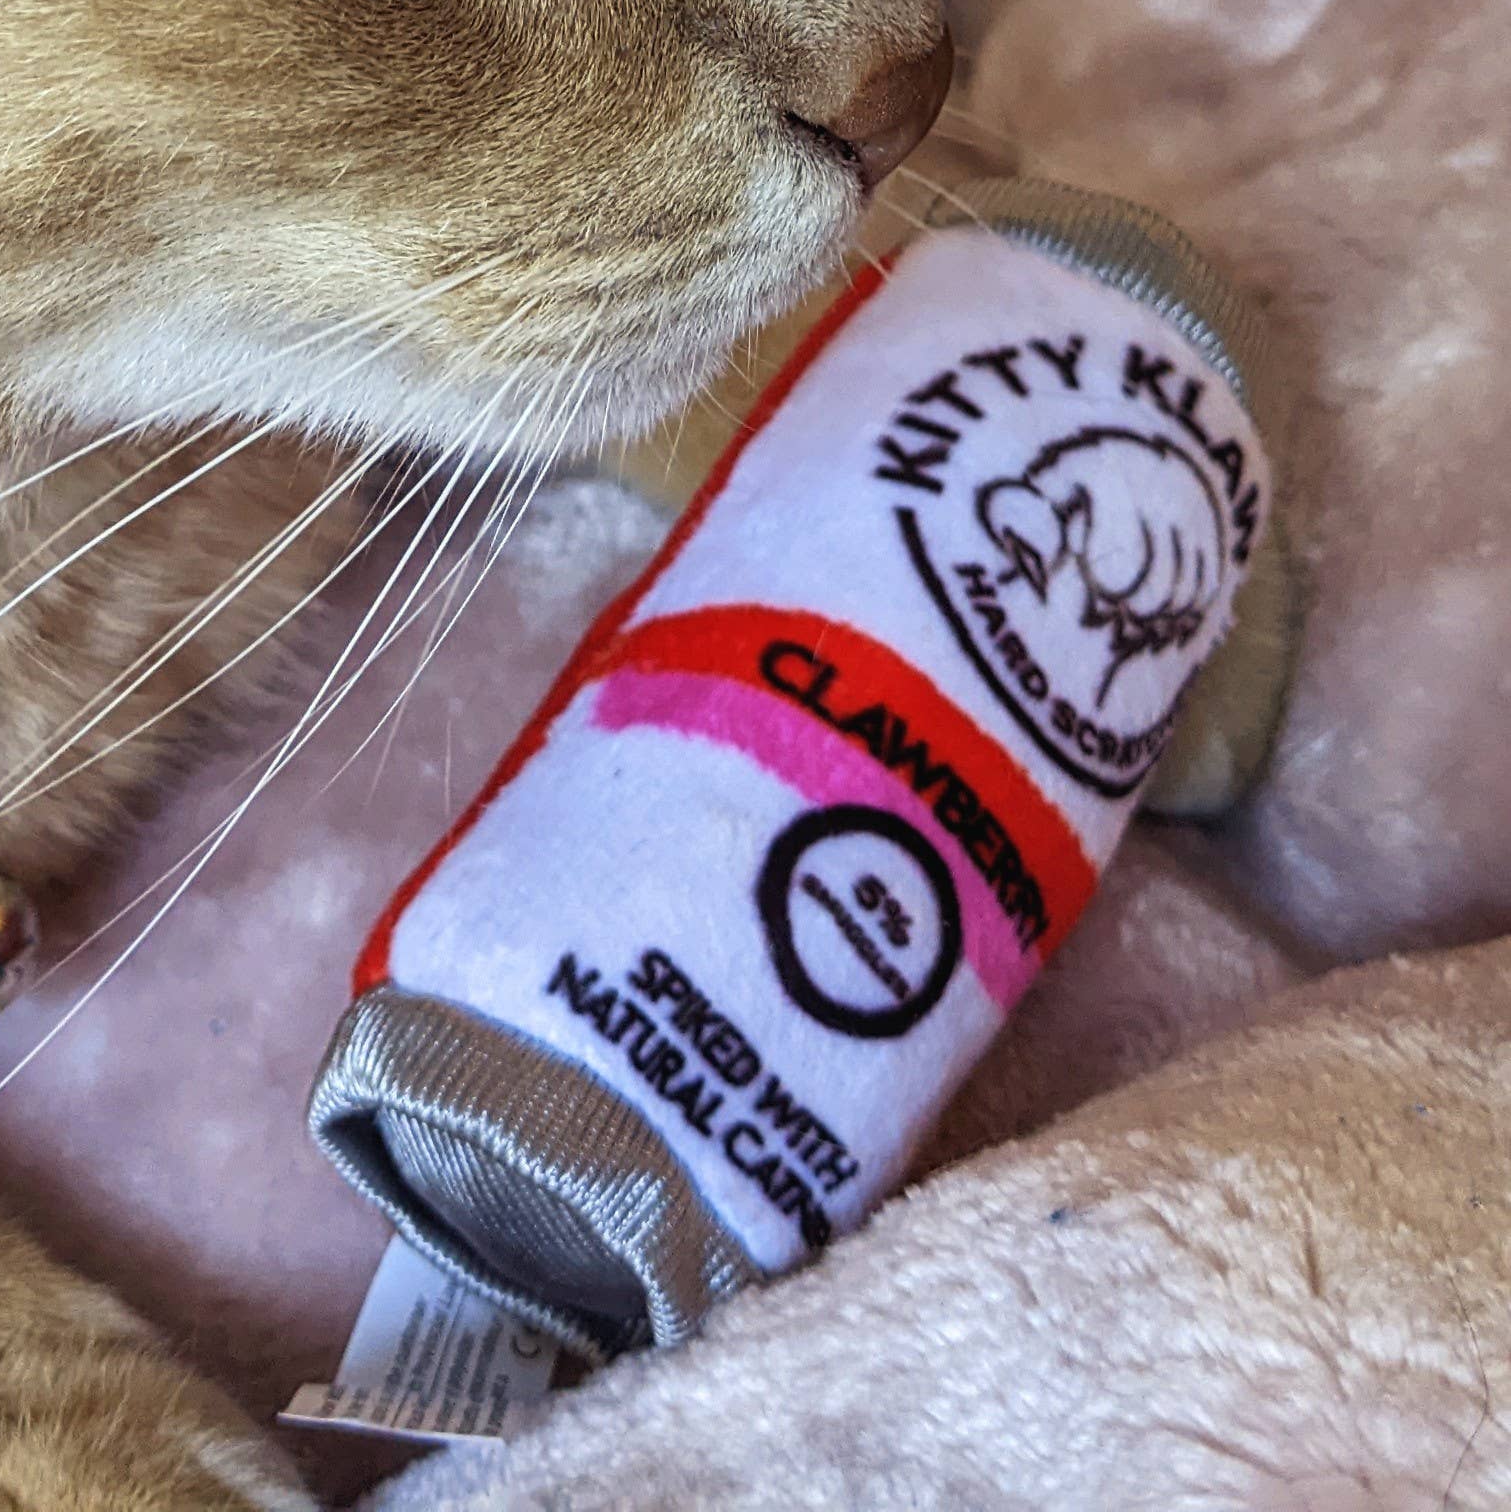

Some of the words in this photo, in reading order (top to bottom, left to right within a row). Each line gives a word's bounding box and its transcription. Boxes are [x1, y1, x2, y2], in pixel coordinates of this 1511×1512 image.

[874, 334, 1085, 495] KITTY
[954, 562, 1050, 703] HARD
[759, 640, 1050, 954] CLAWBERRY
[852, 873, 913, 948] 5%
[546, 952, 728, 1140] NATURAL
[627, 947, 762, 1089] SPIKED
[754, 1071, 860, 1193] WITH
